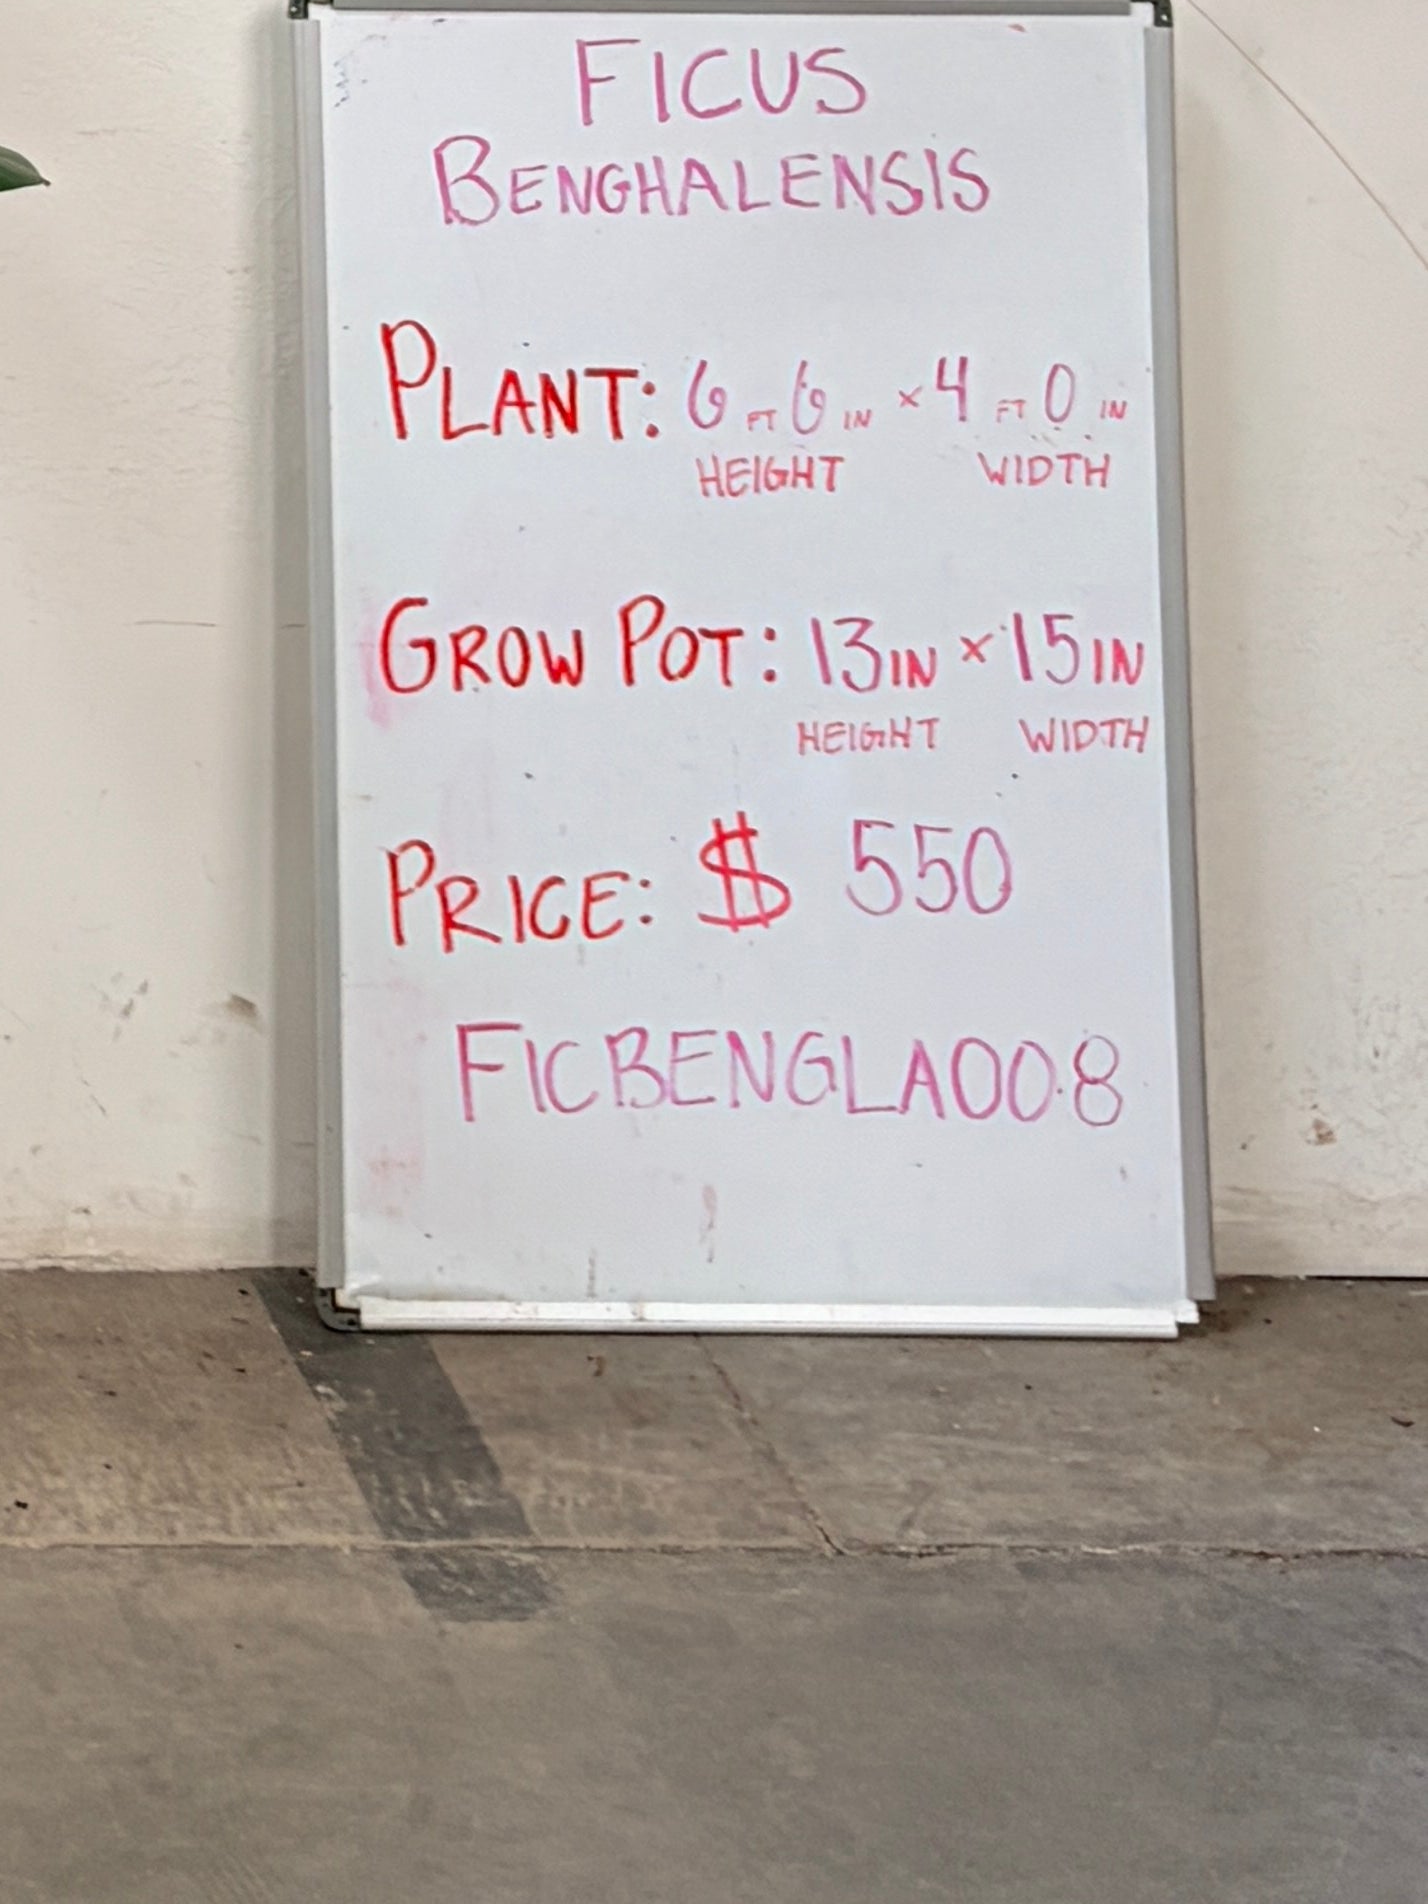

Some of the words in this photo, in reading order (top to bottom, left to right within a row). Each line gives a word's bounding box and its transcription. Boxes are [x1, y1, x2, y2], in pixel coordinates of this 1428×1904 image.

[575, 38, 868, 127] FICUS
[433, 136, 989, 226] BENGHALENSIS
[379, 320, 659, 442] PLANT:
[687, 360, 727, 430] 6
[792, 360, 826, 435] 6
[935, 357, 968, 421] 4
[1045, 364, 1075, 424] 0
[698, 455, 845, 498] HEIGHT
[979, 453, 1109, 487] WIDTH
[377, 597, 585, 696] GROW
[618, 595, 776, 688] POT:
[798, 719, 937, 754] HEIGHT
[1020, 718, 1148, 752] WIDTH
[386, 839, 652, 954] PRICE:
[698, 811, 792, 933] $
[846, 819, 1013, 915] 550
[455, 1021, 1124, 1127] FICBENGLA008
